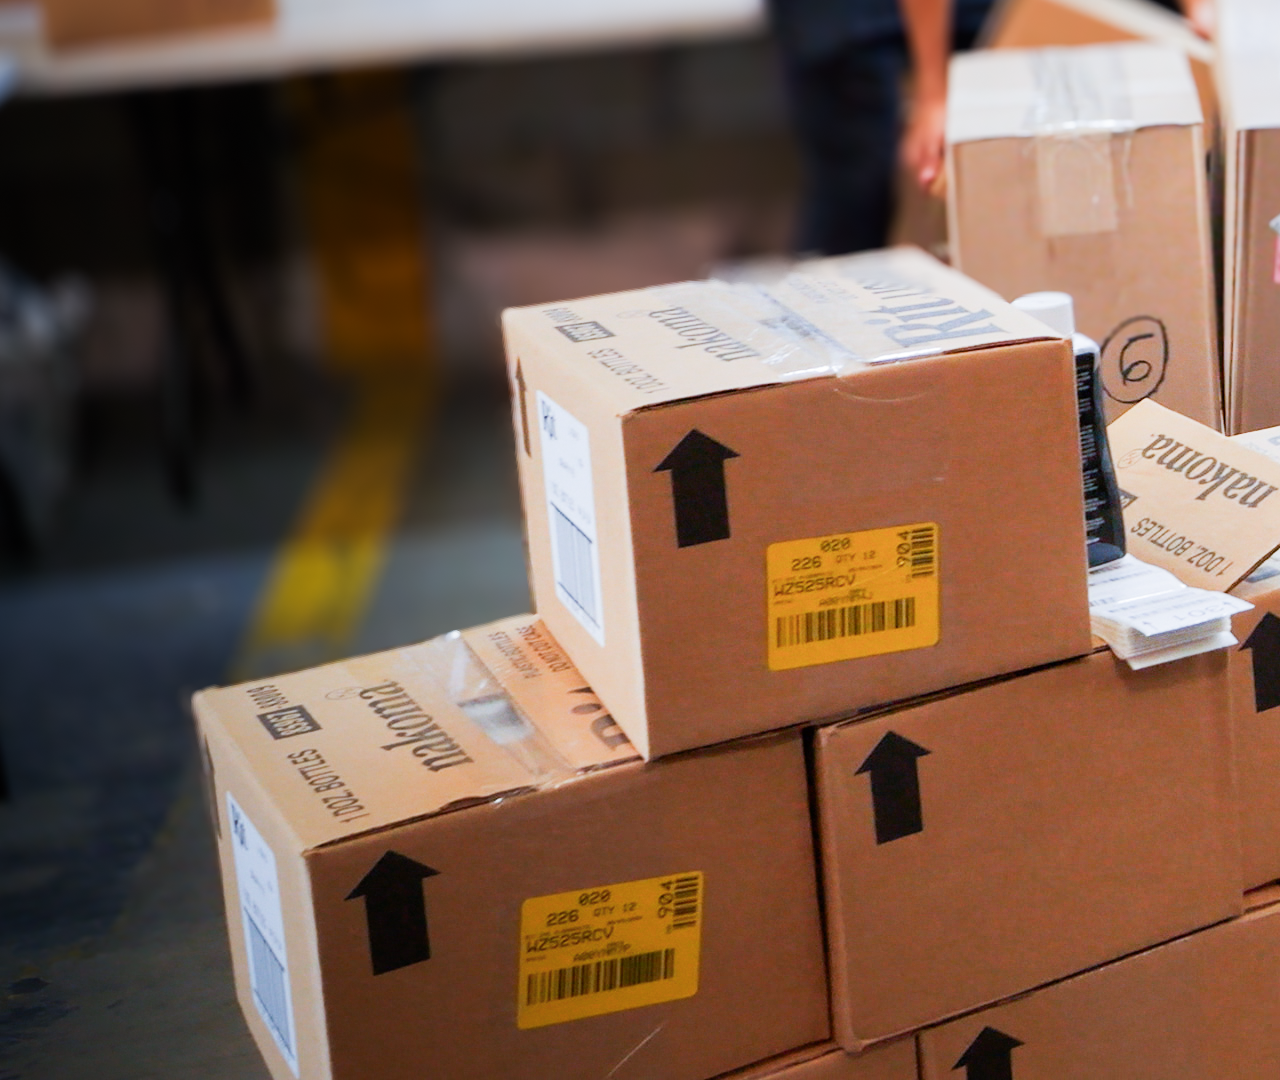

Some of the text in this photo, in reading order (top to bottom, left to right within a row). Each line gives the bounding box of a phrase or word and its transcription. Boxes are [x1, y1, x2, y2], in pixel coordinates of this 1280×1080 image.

[648, 306, 760, 362] nakoma
[860, 297, 1010, 348] Rit
[1141, 433, 1279, 508] nakoma
[792, 555, 822, 571] 226
[820, 537, 851, 553] 020
[896, 530, 911, 568] 904
[1130, 517, 1234, 577] 1 DOZ. BOTTLES
[358, 679, 474, 772] nakoma
[287, 748, 346, 794] BOTTLES
[546, 901, 638, 927] 226 QTY 12
[578, 889, 611, 906] 020
[657, 880, 675, 919] 904
